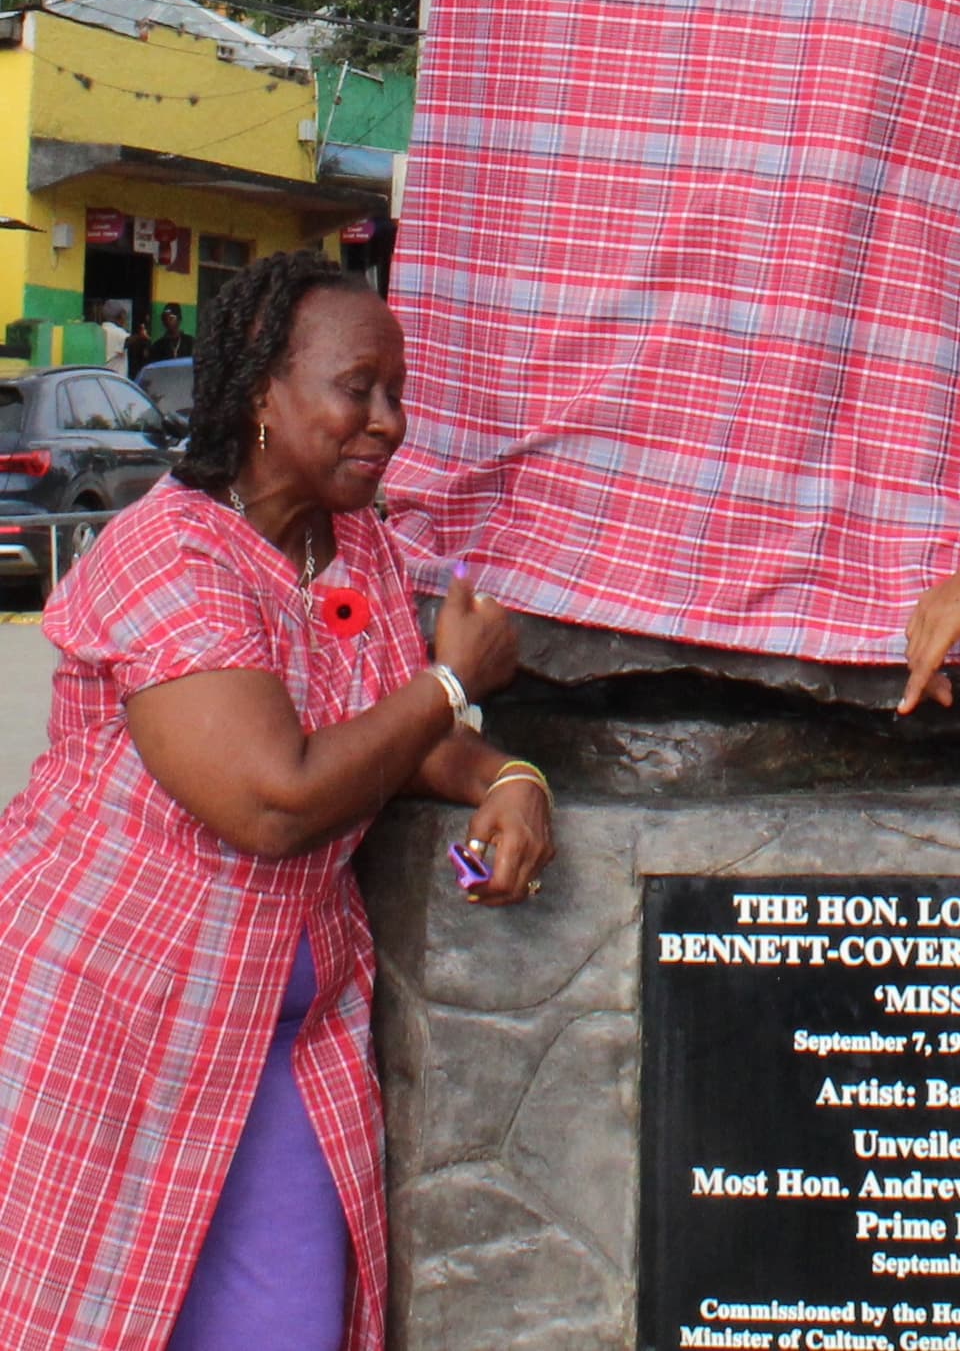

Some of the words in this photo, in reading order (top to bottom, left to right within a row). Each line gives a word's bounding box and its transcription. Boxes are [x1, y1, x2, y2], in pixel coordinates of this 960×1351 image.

[732, 894, 809, 924] THE
[816, 896, 908, 927] HON.
[793, 1030, 908, 1056] September
[911, 1032, 933, 1057] 7,
[815, 1077, 916, 1107] Artist:
[691, 1167, 769, 1196] Most
[776, 1169, 850, 1198] Hon.
[855, 1211, 947, 1240] Prime
[699, 1298, 856, 1322] Commissioned
[861, 1302, 887, 1327] by
[892, 1302, 927, 1324] the
[679, 1326, 774, 1349] Minister
[777, 1328, 802, 1349] of
[805, 1329, 895, 1351] Culture,
